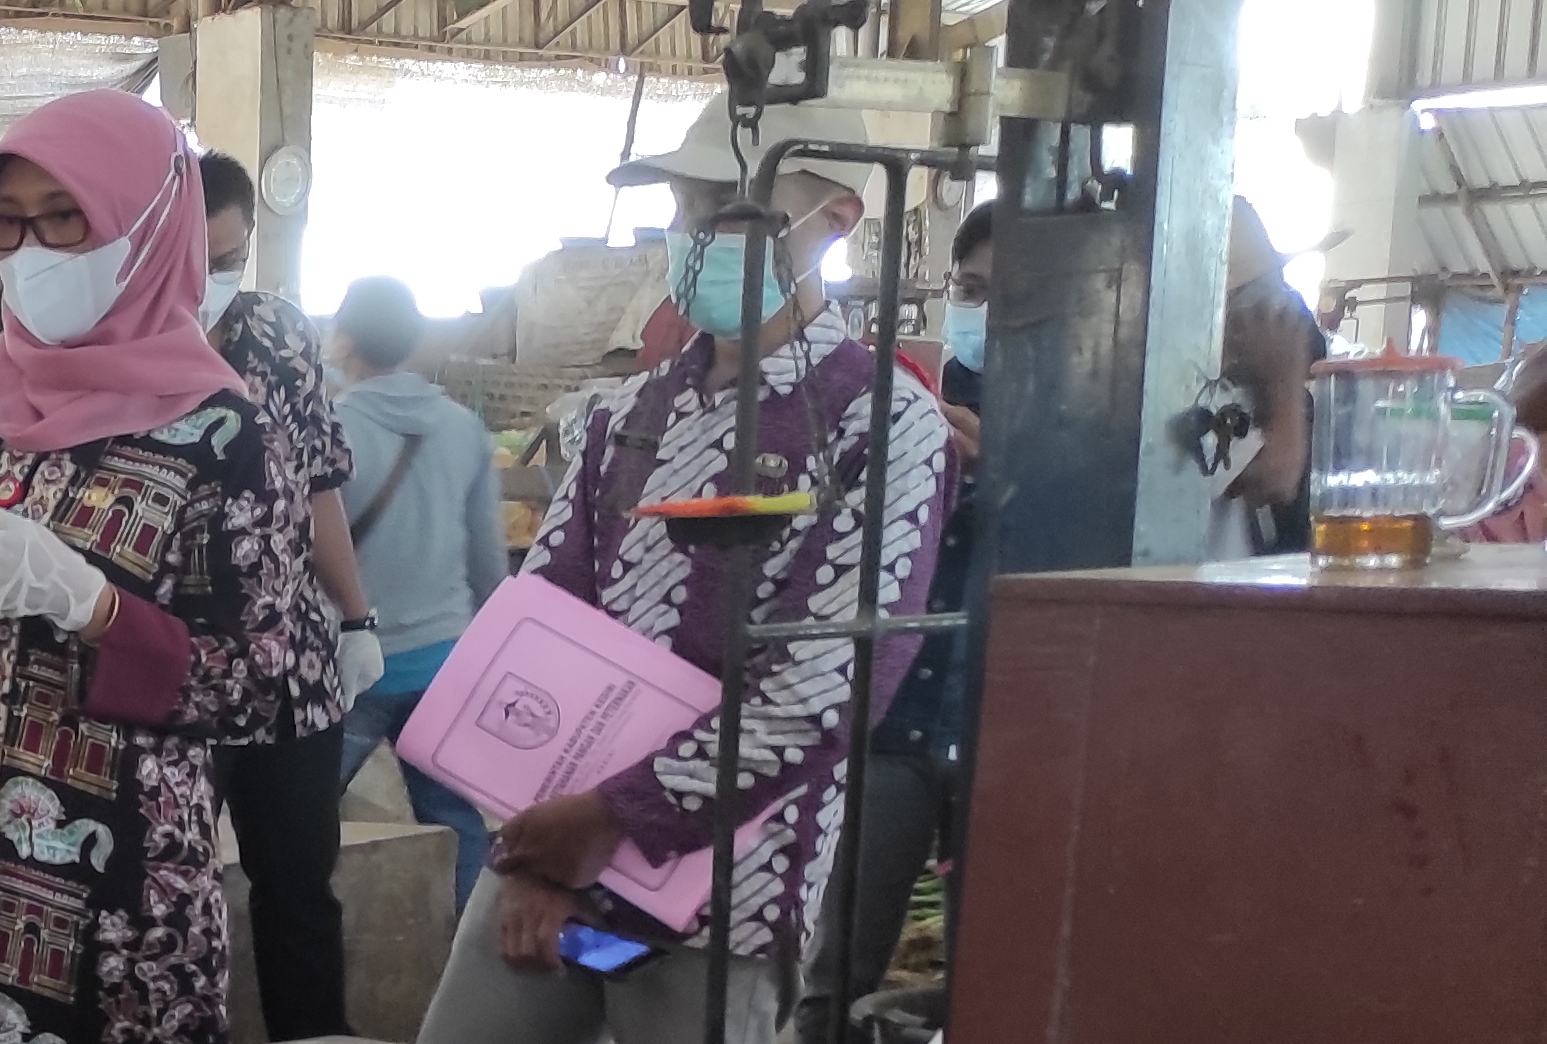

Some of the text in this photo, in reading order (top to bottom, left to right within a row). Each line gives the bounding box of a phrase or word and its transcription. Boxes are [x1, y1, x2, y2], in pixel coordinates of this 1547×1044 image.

[561, 708, 597, 755] KABUPATEN
[592, 681, 616, 709] KEDIRI
[589, 719, 607, 736] DAN
